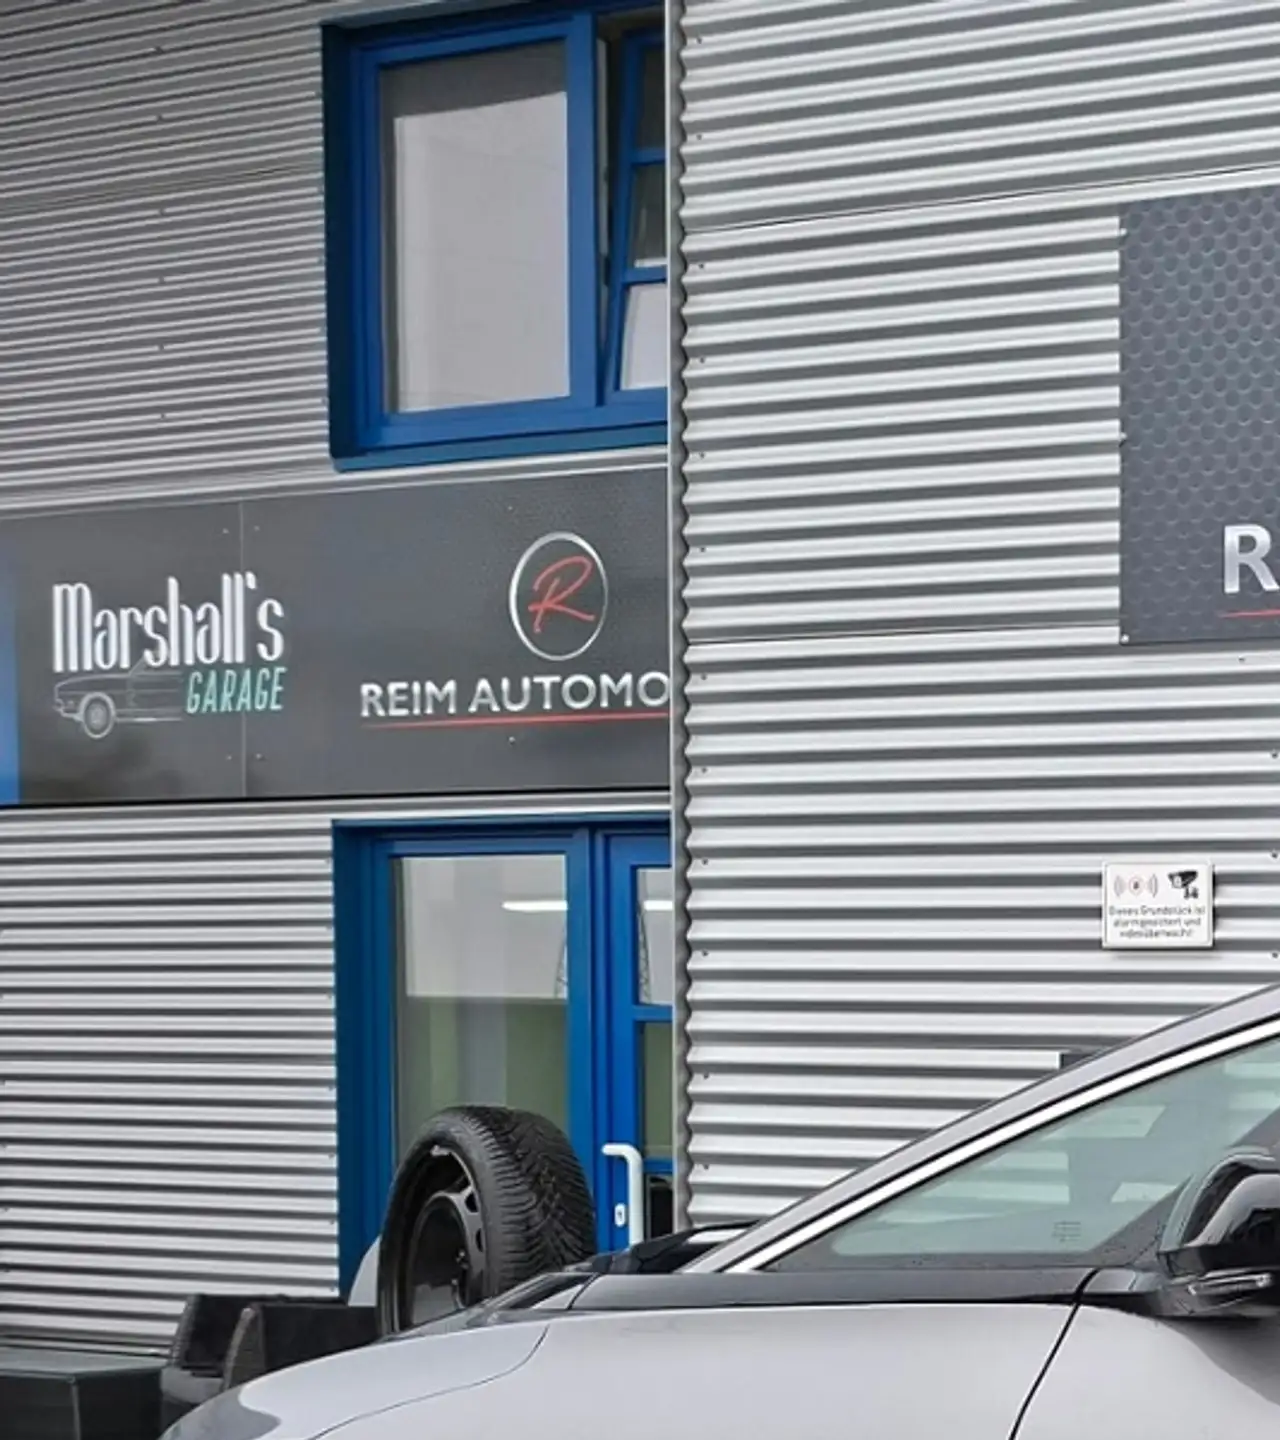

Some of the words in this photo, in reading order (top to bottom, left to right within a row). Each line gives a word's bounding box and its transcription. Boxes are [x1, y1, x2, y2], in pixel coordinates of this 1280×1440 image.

[53, 571, 285, 673] Marshall's
[528, 555, 595, 634] R
[186, 666, 287, 715] GARAGE
[360, 679, 457, 718] REIM
[468, 671, 671, 714] AUTOMO
